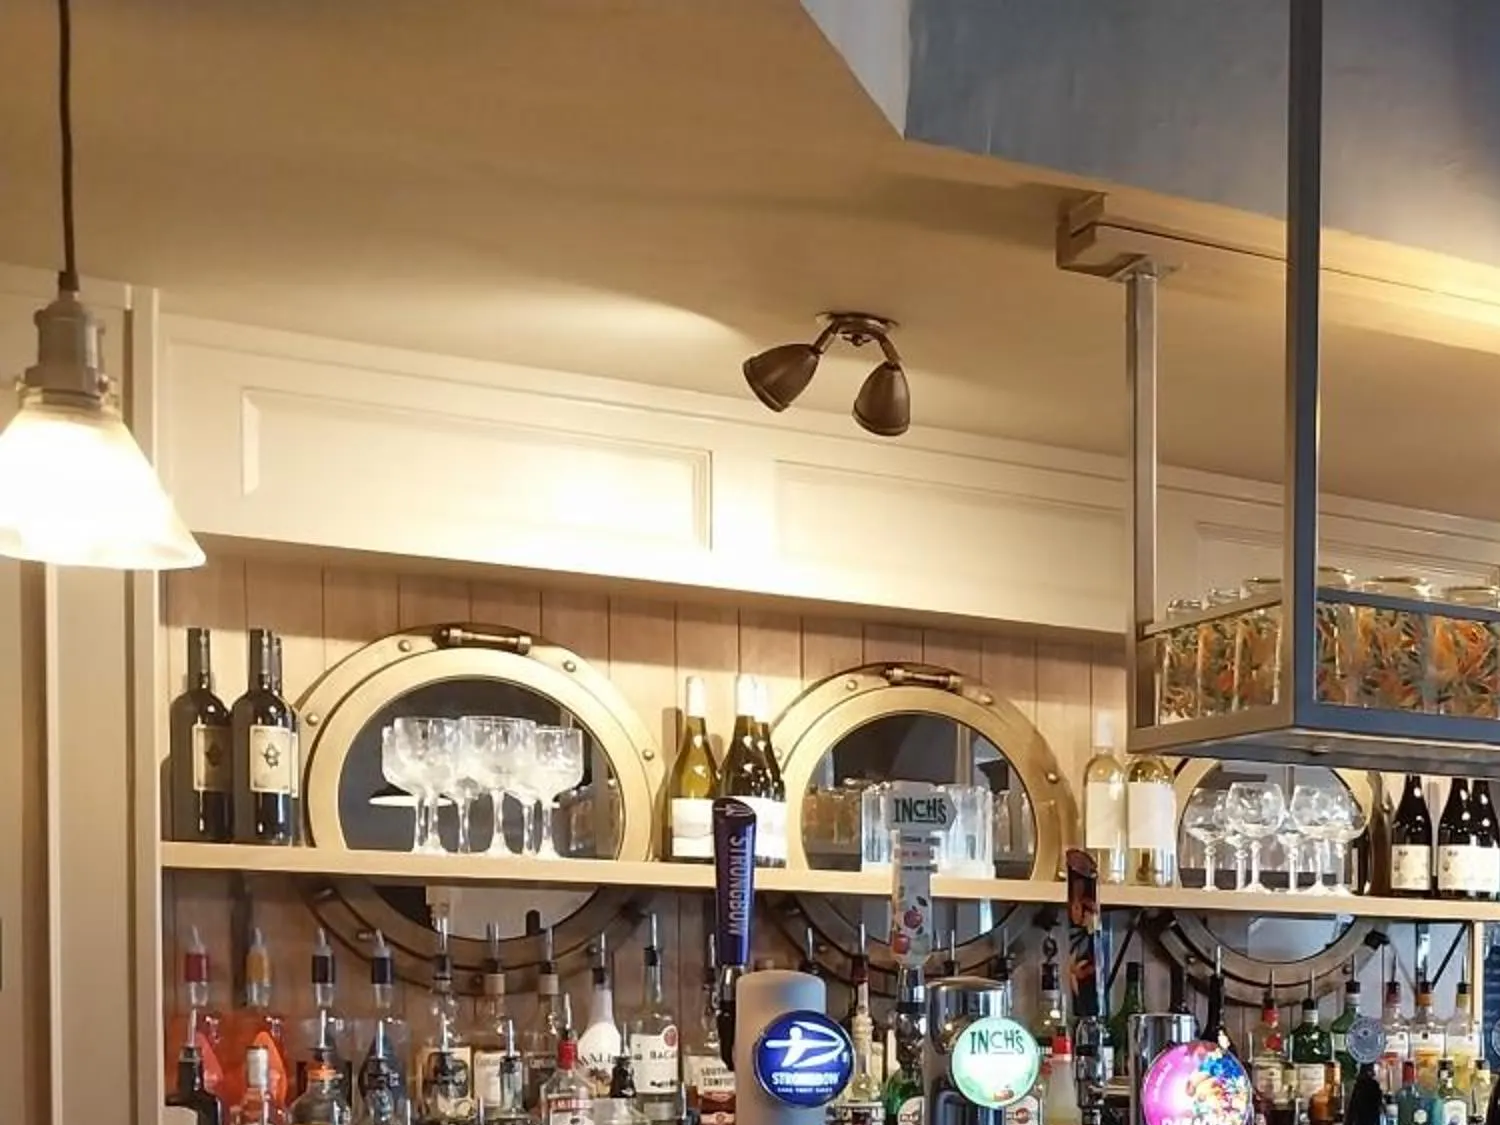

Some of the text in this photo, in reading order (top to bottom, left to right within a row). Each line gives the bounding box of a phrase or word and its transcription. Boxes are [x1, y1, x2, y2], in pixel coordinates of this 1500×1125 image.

[893, 797, 947, 825] INCH'S
[728, 835, 749, 936] STRONGBOW
[969, 1029, 1025, 1055] INCH'S
